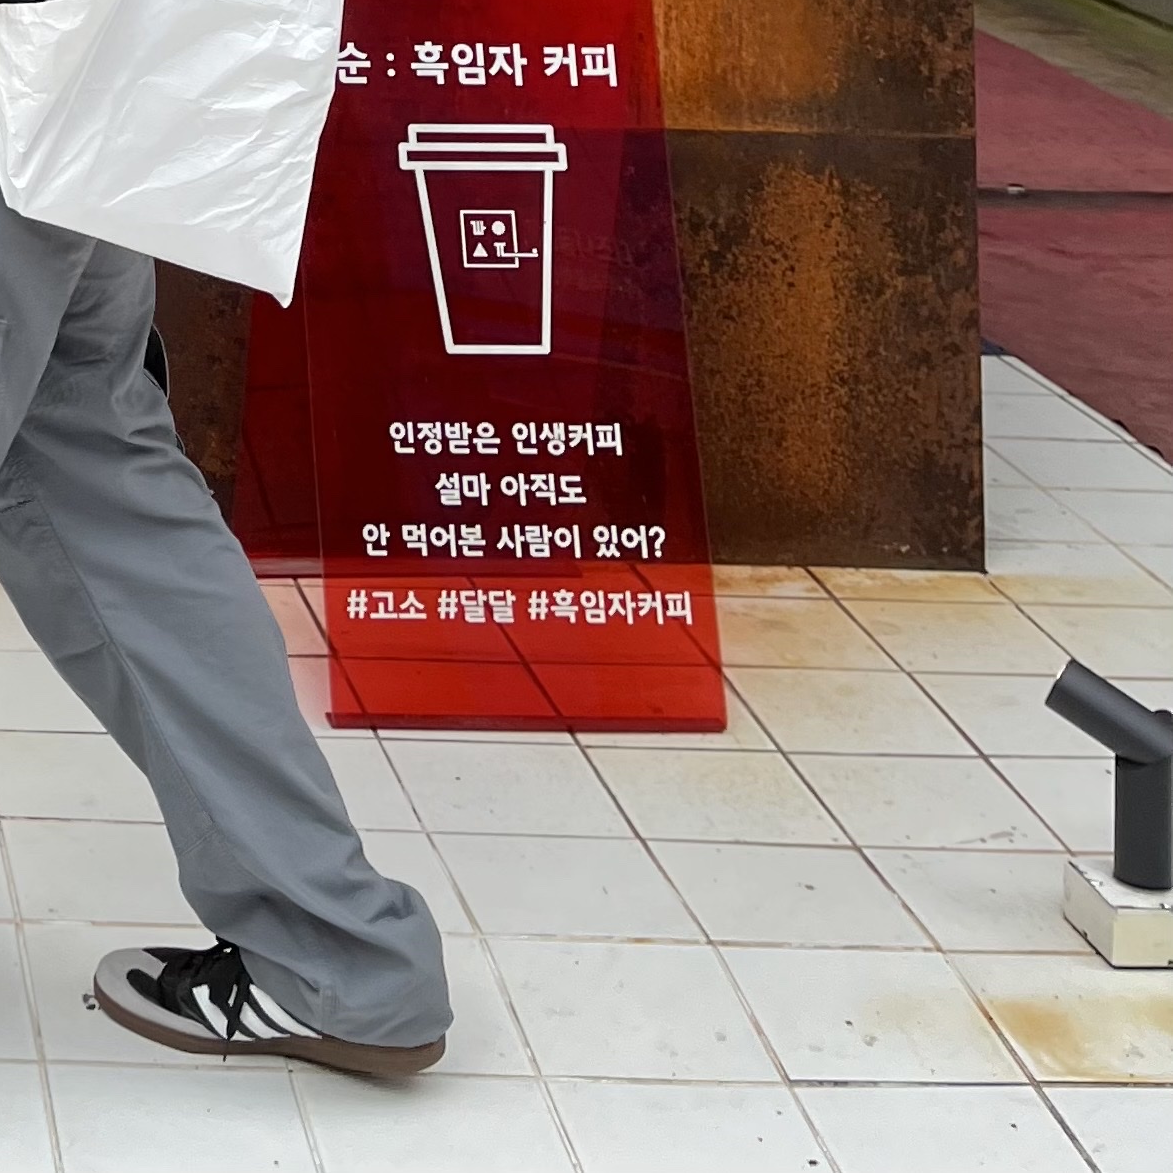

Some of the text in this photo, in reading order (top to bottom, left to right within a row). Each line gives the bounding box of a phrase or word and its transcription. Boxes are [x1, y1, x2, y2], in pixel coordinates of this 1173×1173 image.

[336, 41, 372, 85] 순
[410, 40, 528, 87] 흑임자
[543, 43, 619, 88] 커피
[389, 421, 624, 457] 인정받은 인생커피
[434, 472, 588, 507] 설마 아직도
[362, 523, 667, 560] 안 먹어본 사람이 있어?
[346, 588, 694, 626] #고소 #달달 #흑임자커피
